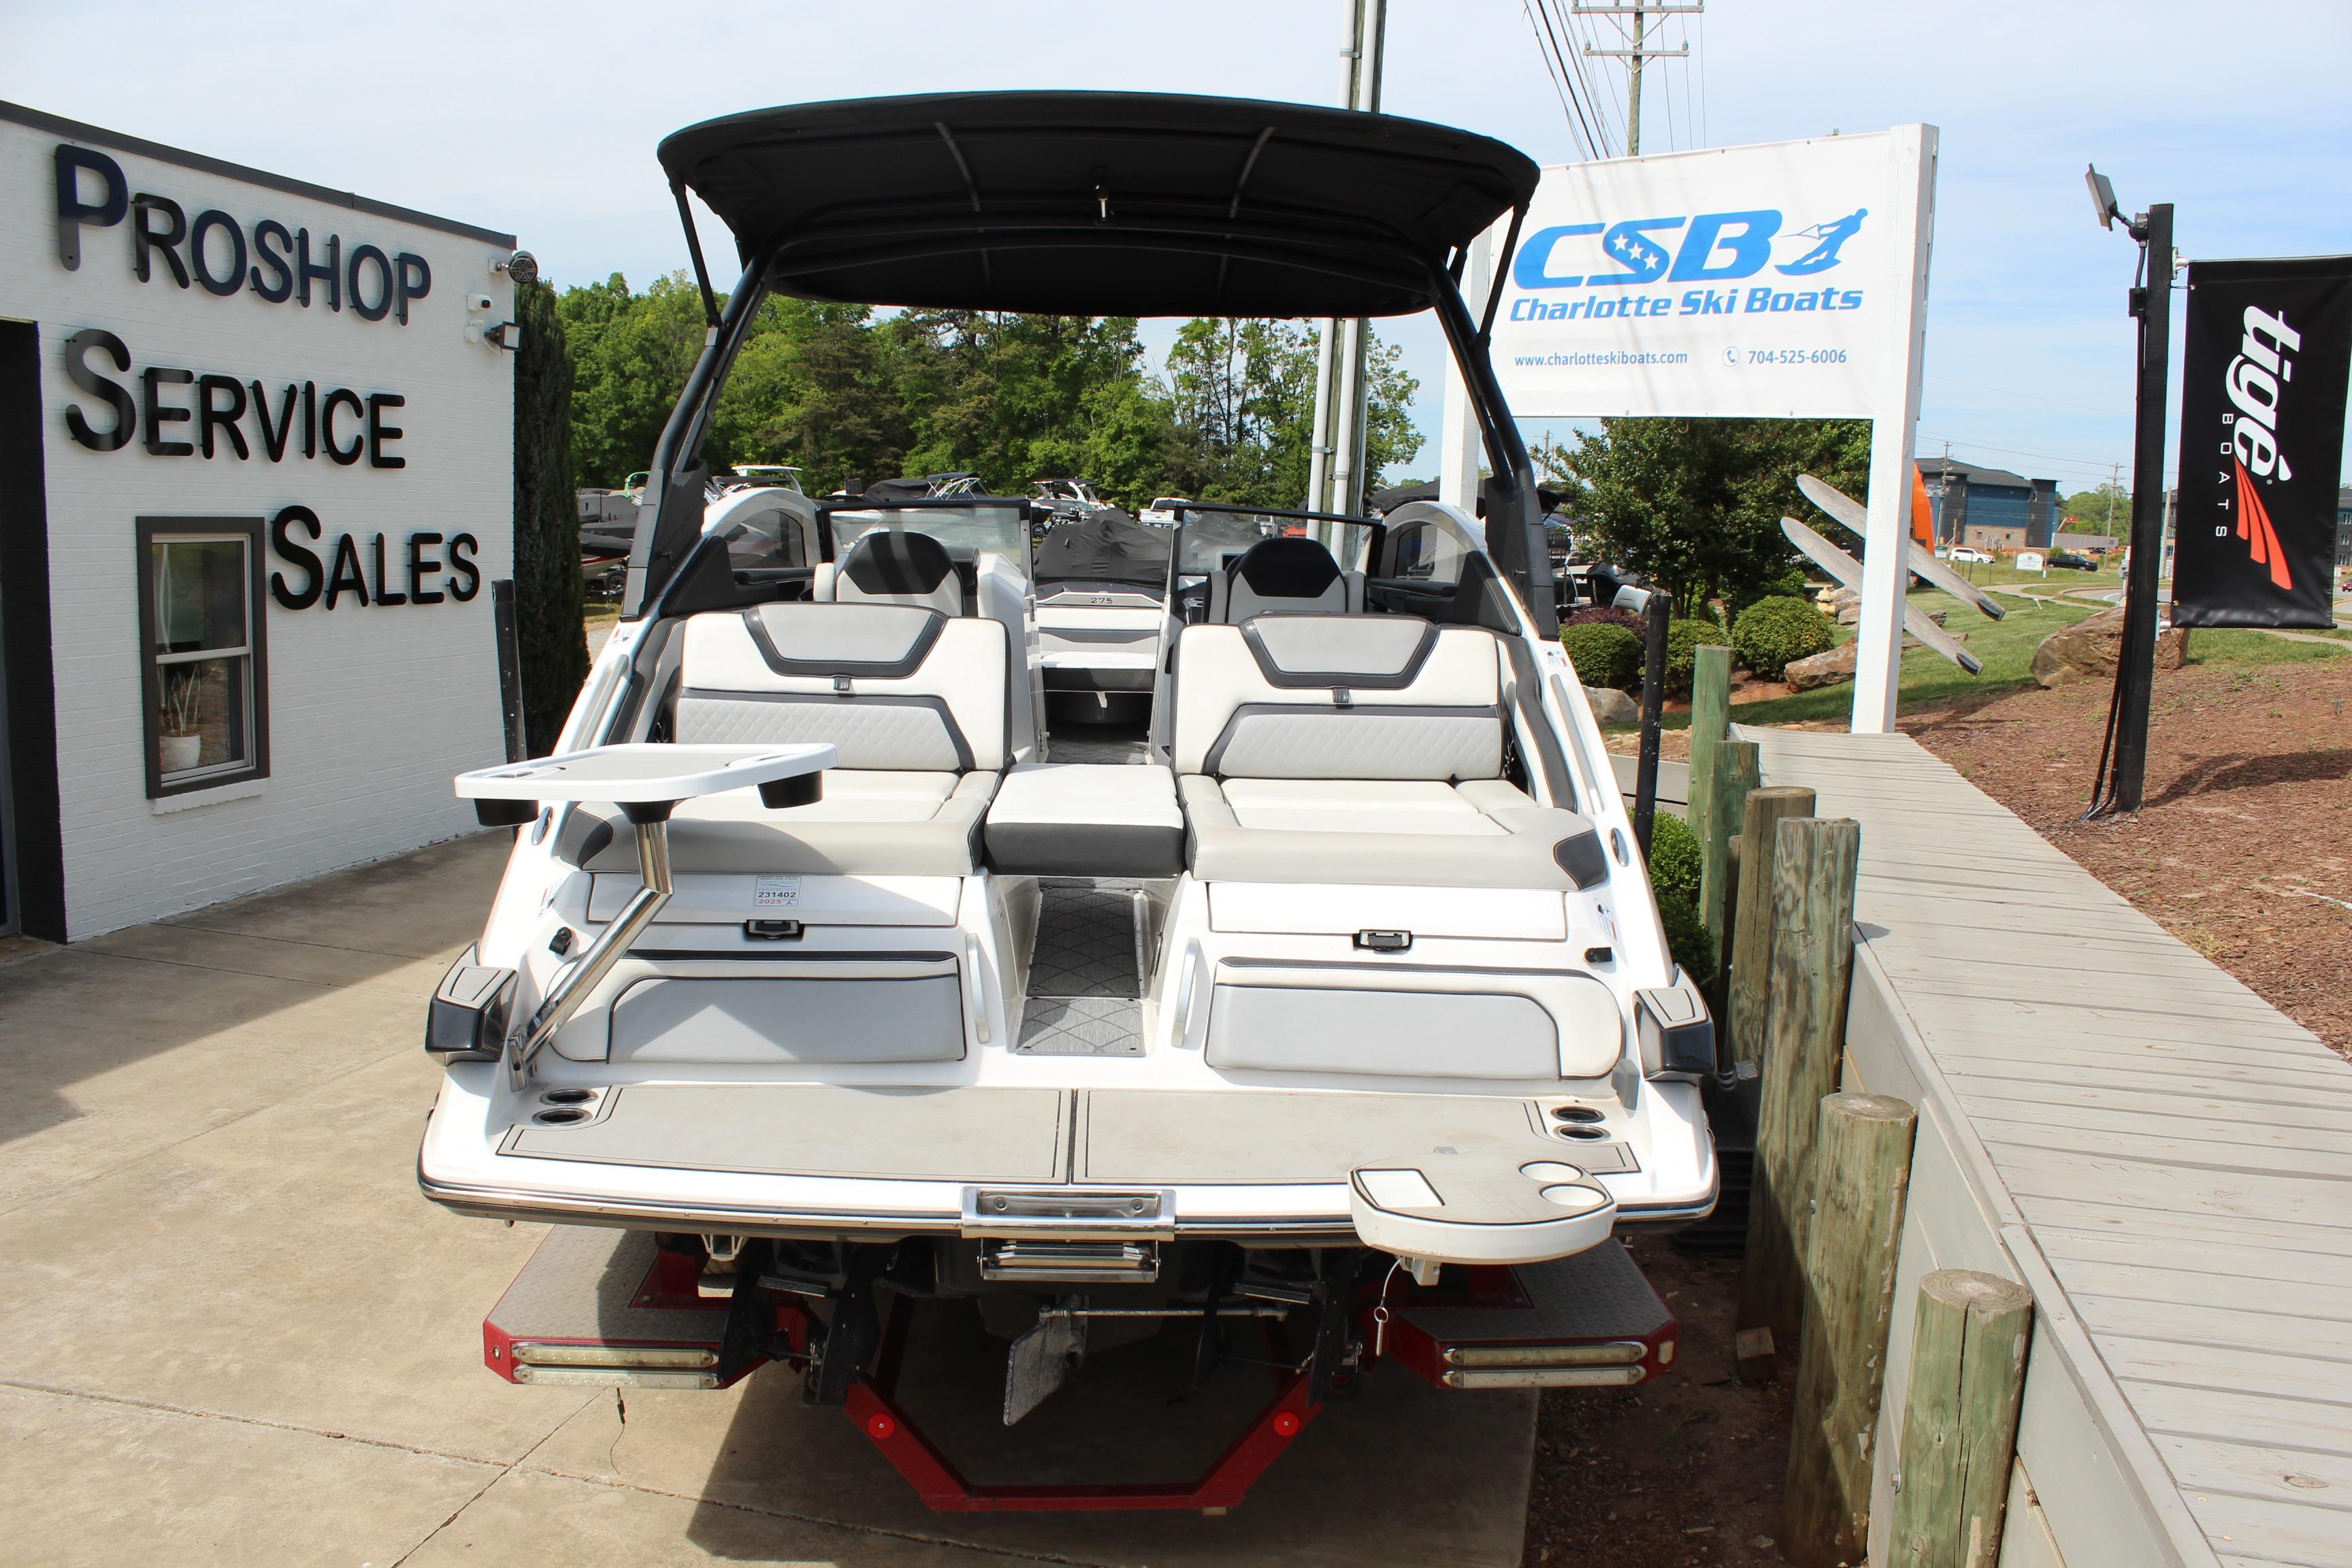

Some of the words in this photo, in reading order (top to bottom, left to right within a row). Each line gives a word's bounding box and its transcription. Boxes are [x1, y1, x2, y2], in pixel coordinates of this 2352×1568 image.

[56, 143, 431, 327] PROSHOP
[1513, 210, 1783, 290] CSB
[1510, 294, 1670, 321] Charlotte
[1678, 287, 1738, 315] Ski
[1744, 287, 1863, 314] Boats
[1514, 351, 1688, 367] www.charlotteskiboats.com
[1748, 348, 1848, 365] 704-525-6006
[65, 328, 407, 469] SERVICE
[2225, 305, 2302, 482] tigé
[2215, 412, 2235, 538] BOATS
[270, 504, 480, 611] SALES
